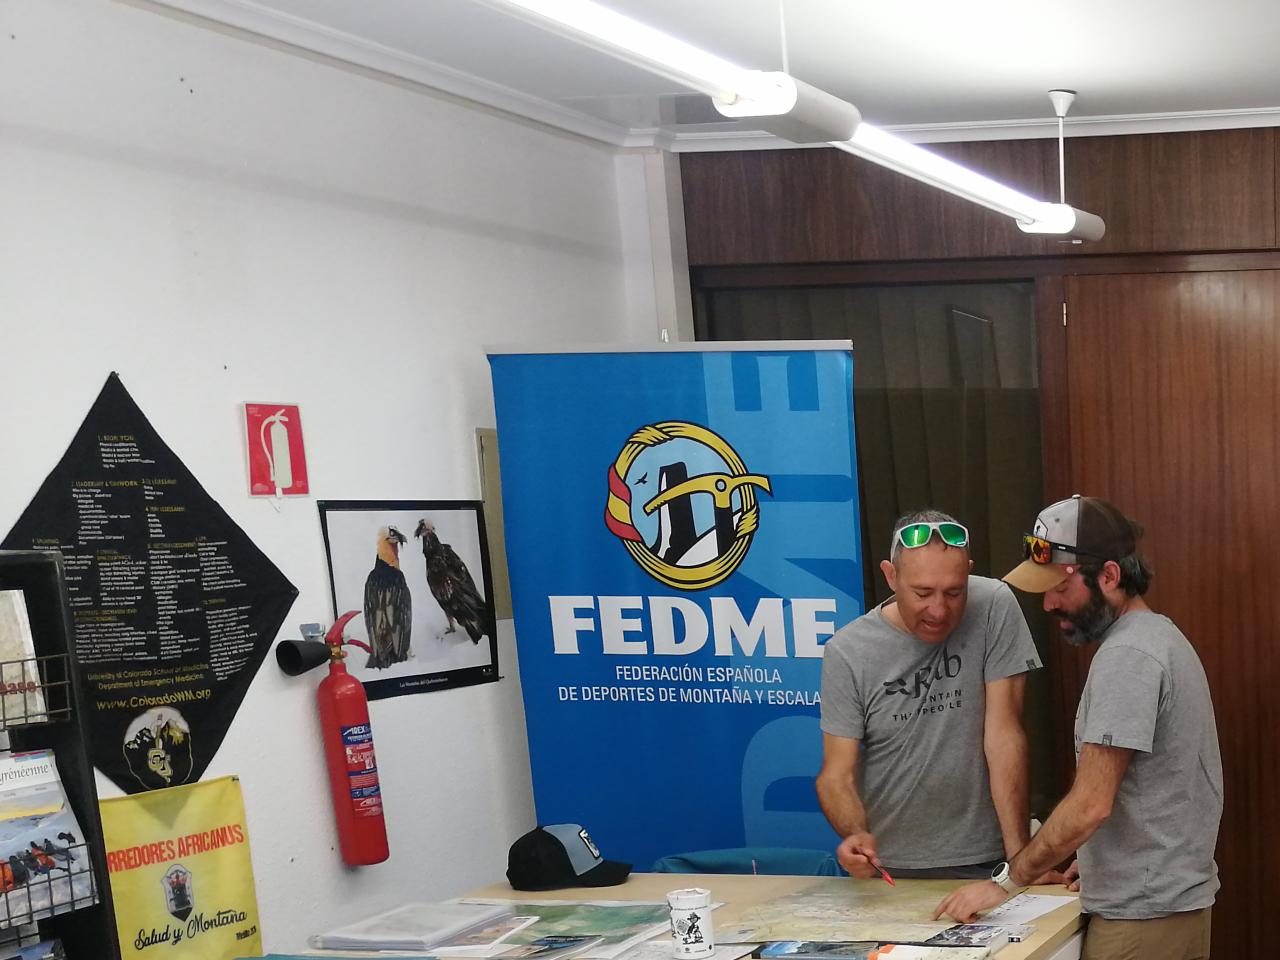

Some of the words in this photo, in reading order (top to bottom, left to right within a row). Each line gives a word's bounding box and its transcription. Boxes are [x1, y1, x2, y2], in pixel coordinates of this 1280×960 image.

[548, 595, 837, 658] FEDME
[616, 663, 703, 683] FEDERACIÓN
[707, 664, 782, 684] ESPAÑOLA
[558, 685, 579, 701] DE
[582, 686, 655, 703] DEPORTES
[658, 687, 677, 703] DE
[680, 684, 752, 704] MONTAÑA
[755, 688, 765, 704] Y
[178, 824, 244, 858] AFRICANUS
[134, 924, 171, 951] Salud
[172, 928, 184, 945] y
